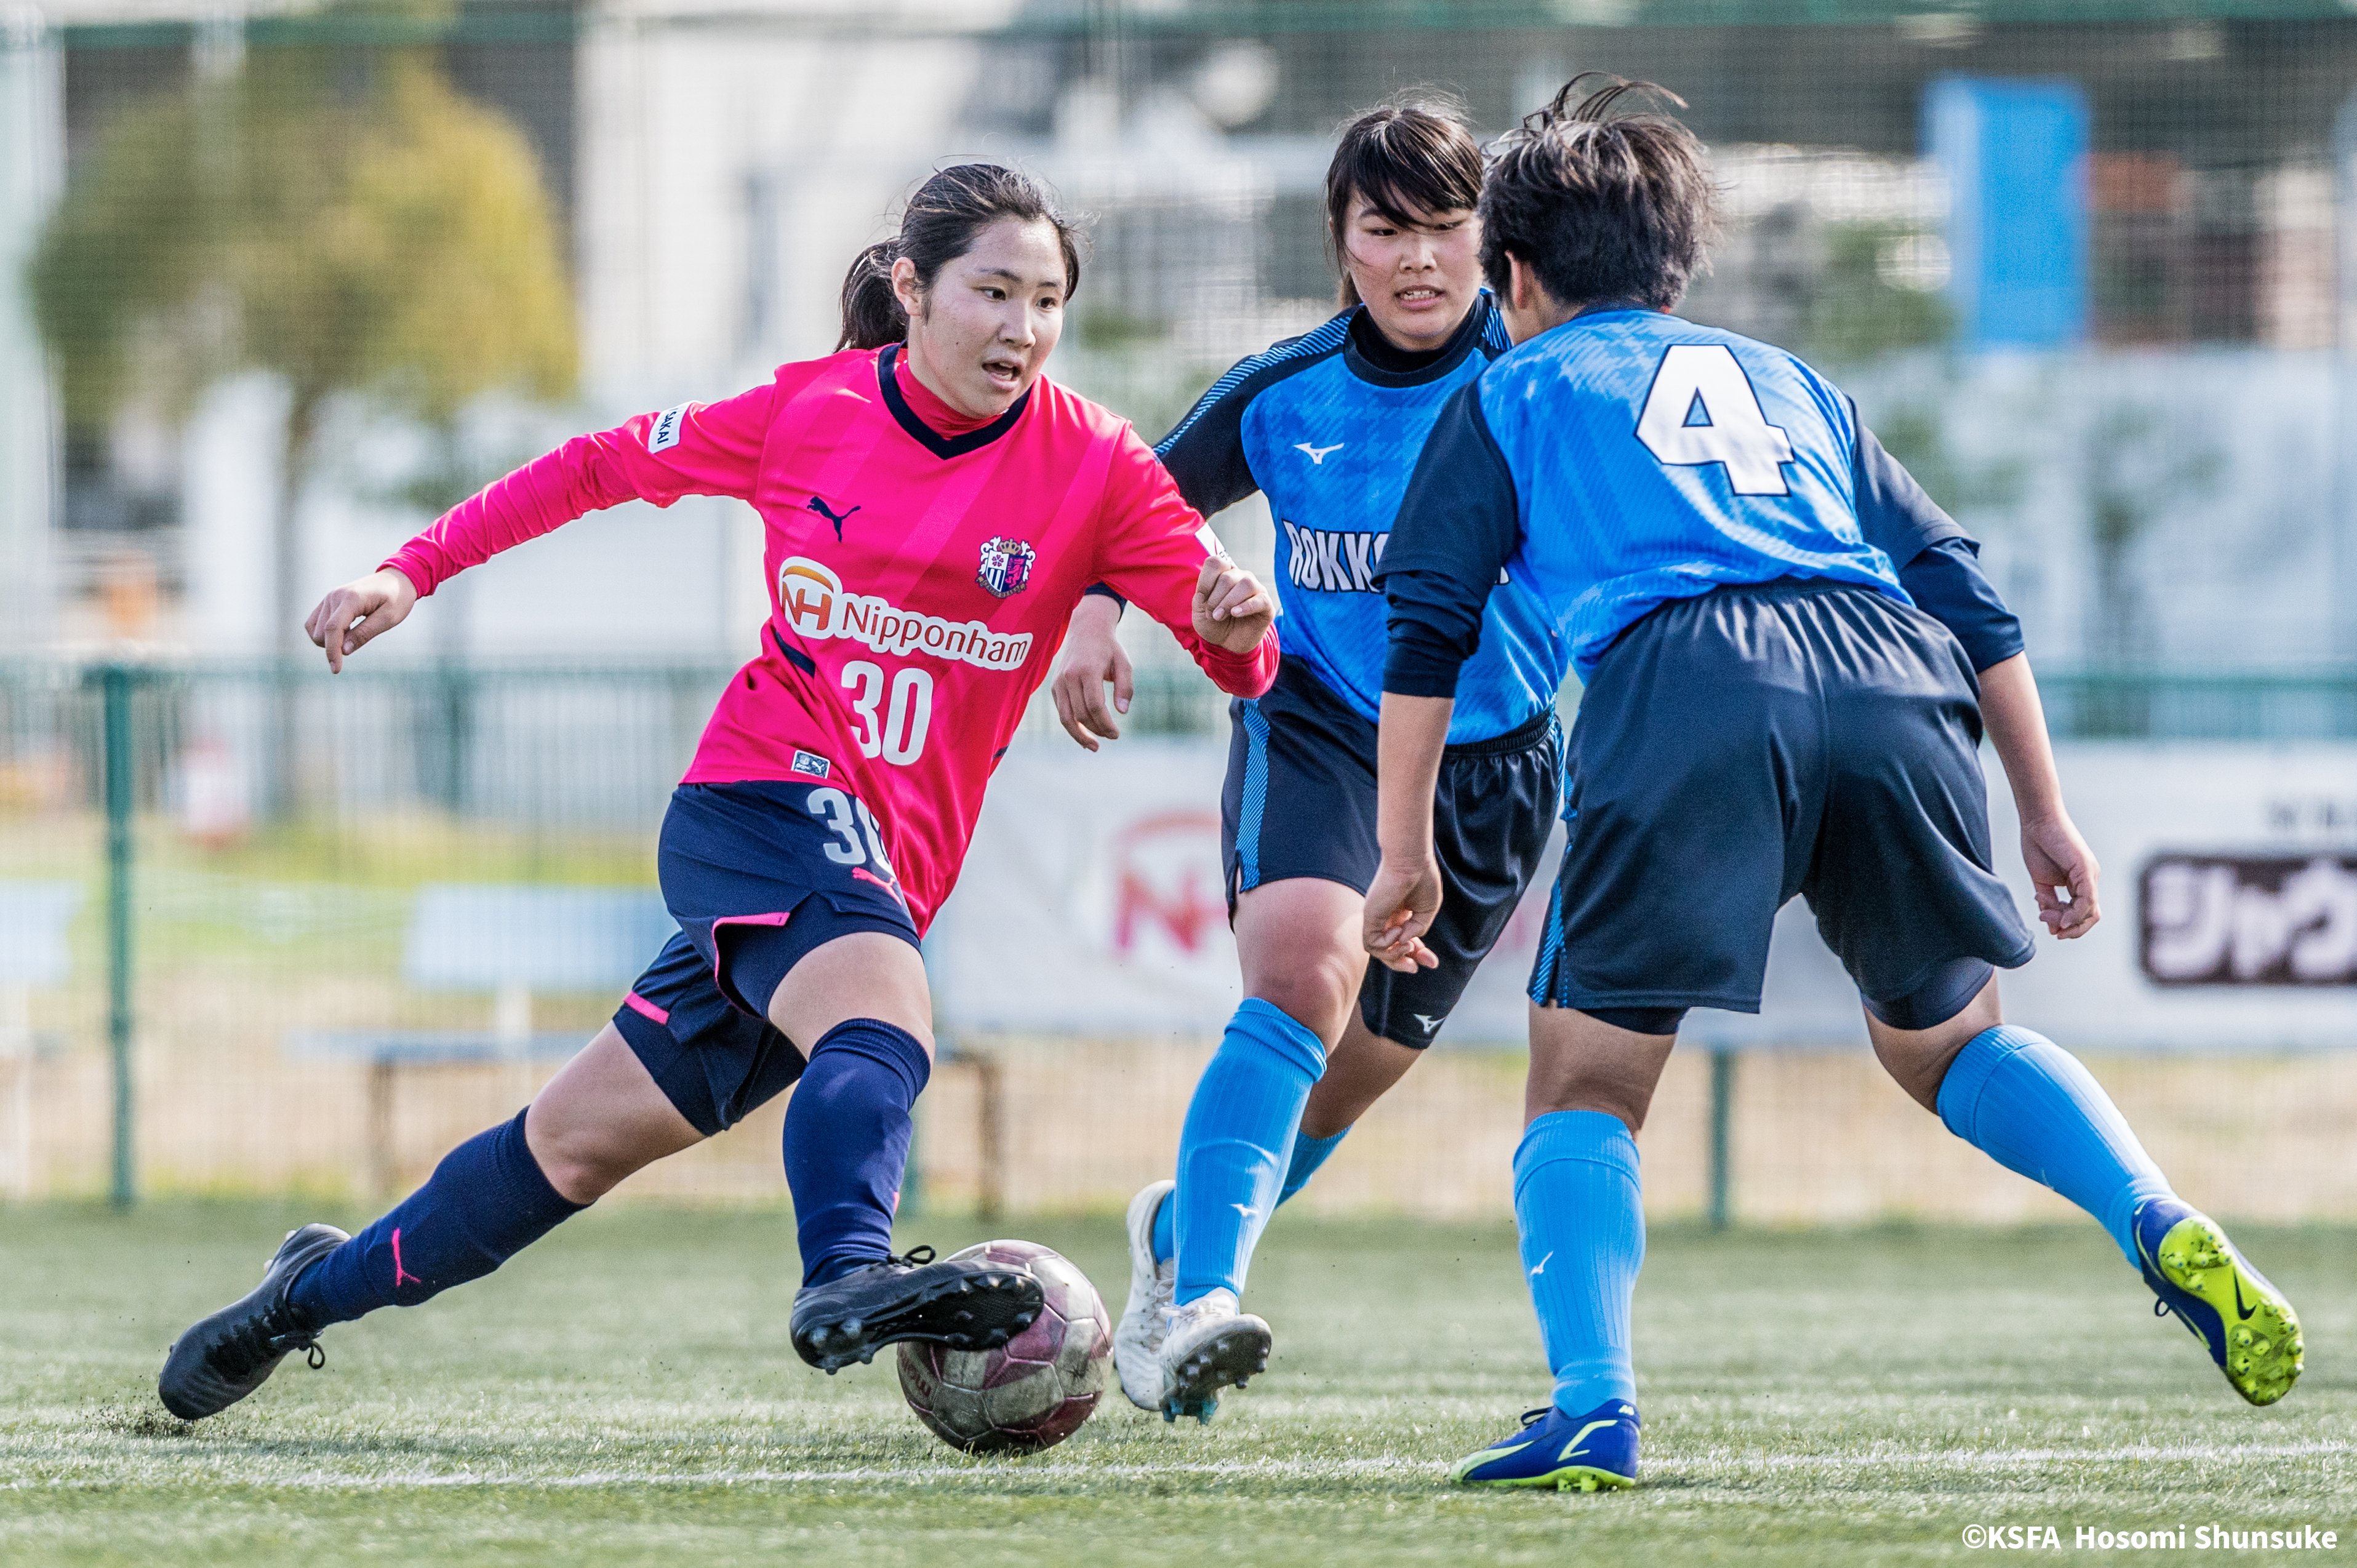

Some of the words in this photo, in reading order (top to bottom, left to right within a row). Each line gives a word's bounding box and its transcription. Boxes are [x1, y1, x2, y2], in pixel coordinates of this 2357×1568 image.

[1634, 343, 1795, 497] 4
[1282, 519, 1390, 593] ROKK
[782, 580, 833, 631] NH
[842, 601, 1028, 663] Nipponham
[841, 660, 934, 766] 30
